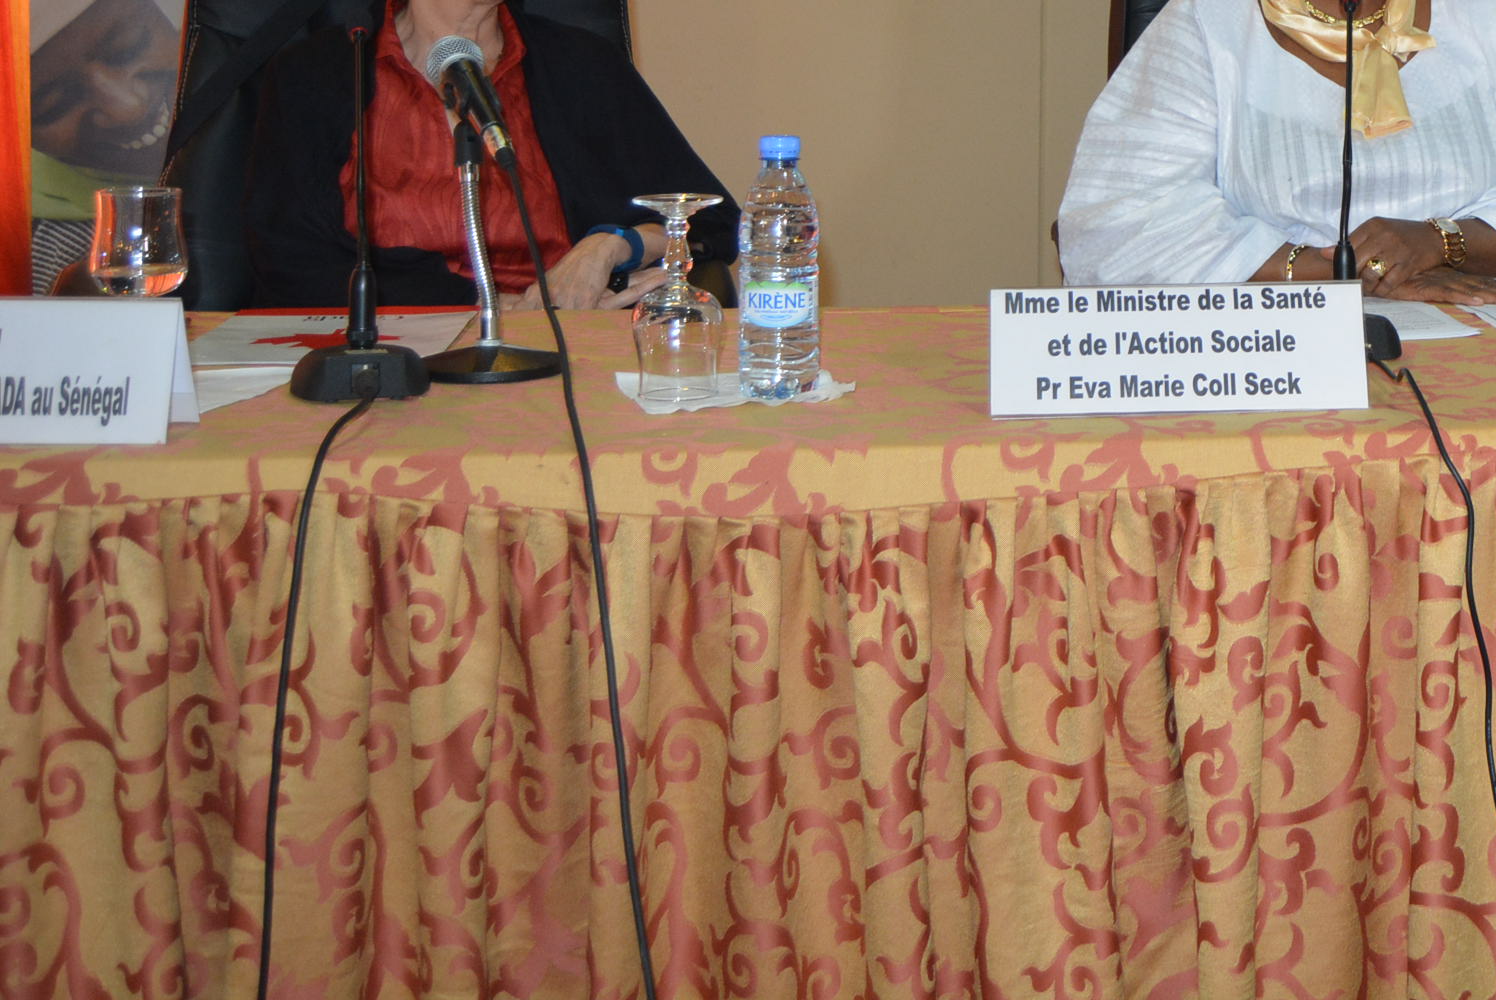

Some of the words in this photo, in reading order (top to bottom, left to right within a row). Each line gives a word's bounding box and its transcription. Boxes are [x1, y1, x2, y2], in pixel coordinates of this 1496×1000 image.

[1005, 291, 1060, 314] Mme
[1067, 291, 1089, 313] le
[1096, 288, 1191, 312] Ministre
[1198, 288, 1225, 310] de
[1232, 287, 1254, 310] la
[1260, 285, 1327, 309] Santé
[1047, 334, 1072, 357] et
[1078, 332, 1107, 356] de
[1115, 331, 1203, 355] l'Action
[1211, 329, 1296, 353] Sociale
[1036, 377, 1061, 400] Pr
[1069, 375, 1112, 399] Eva
[1119, 373, 1185, 398] Marie
[1192, 372, 1236, 397] Coll
[1244, 371, 1302, 396] Seck
[0, 376, 25, 416] DA
[31, 386, 54, 416] au
[58, 375, 130, 427] Sénégal
